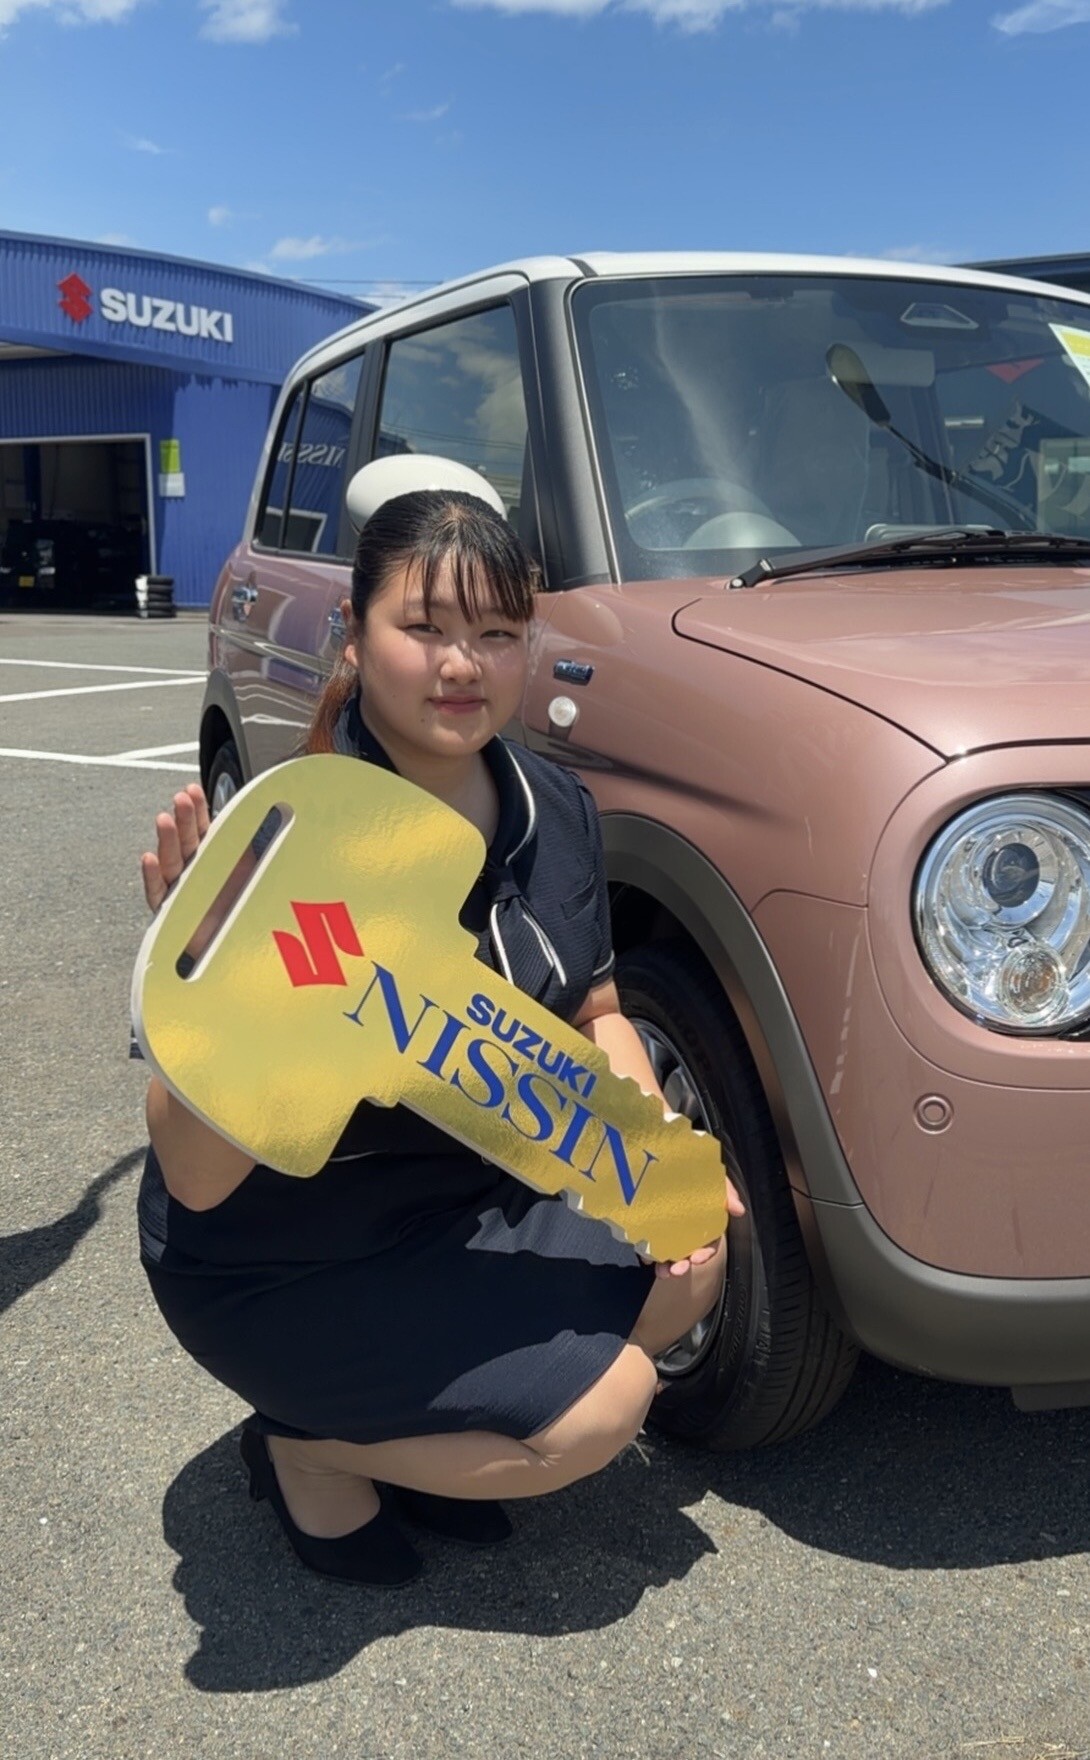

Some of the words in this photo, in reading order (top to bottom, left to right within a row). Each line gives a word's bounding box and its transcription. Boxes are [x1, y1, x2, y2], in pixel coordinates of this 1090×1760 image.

[100, 287, 233, 343] SUZUKI
[342, 961, 659, 1206] NISSIN
[466, 993, 597, 1098] SUZUKI
